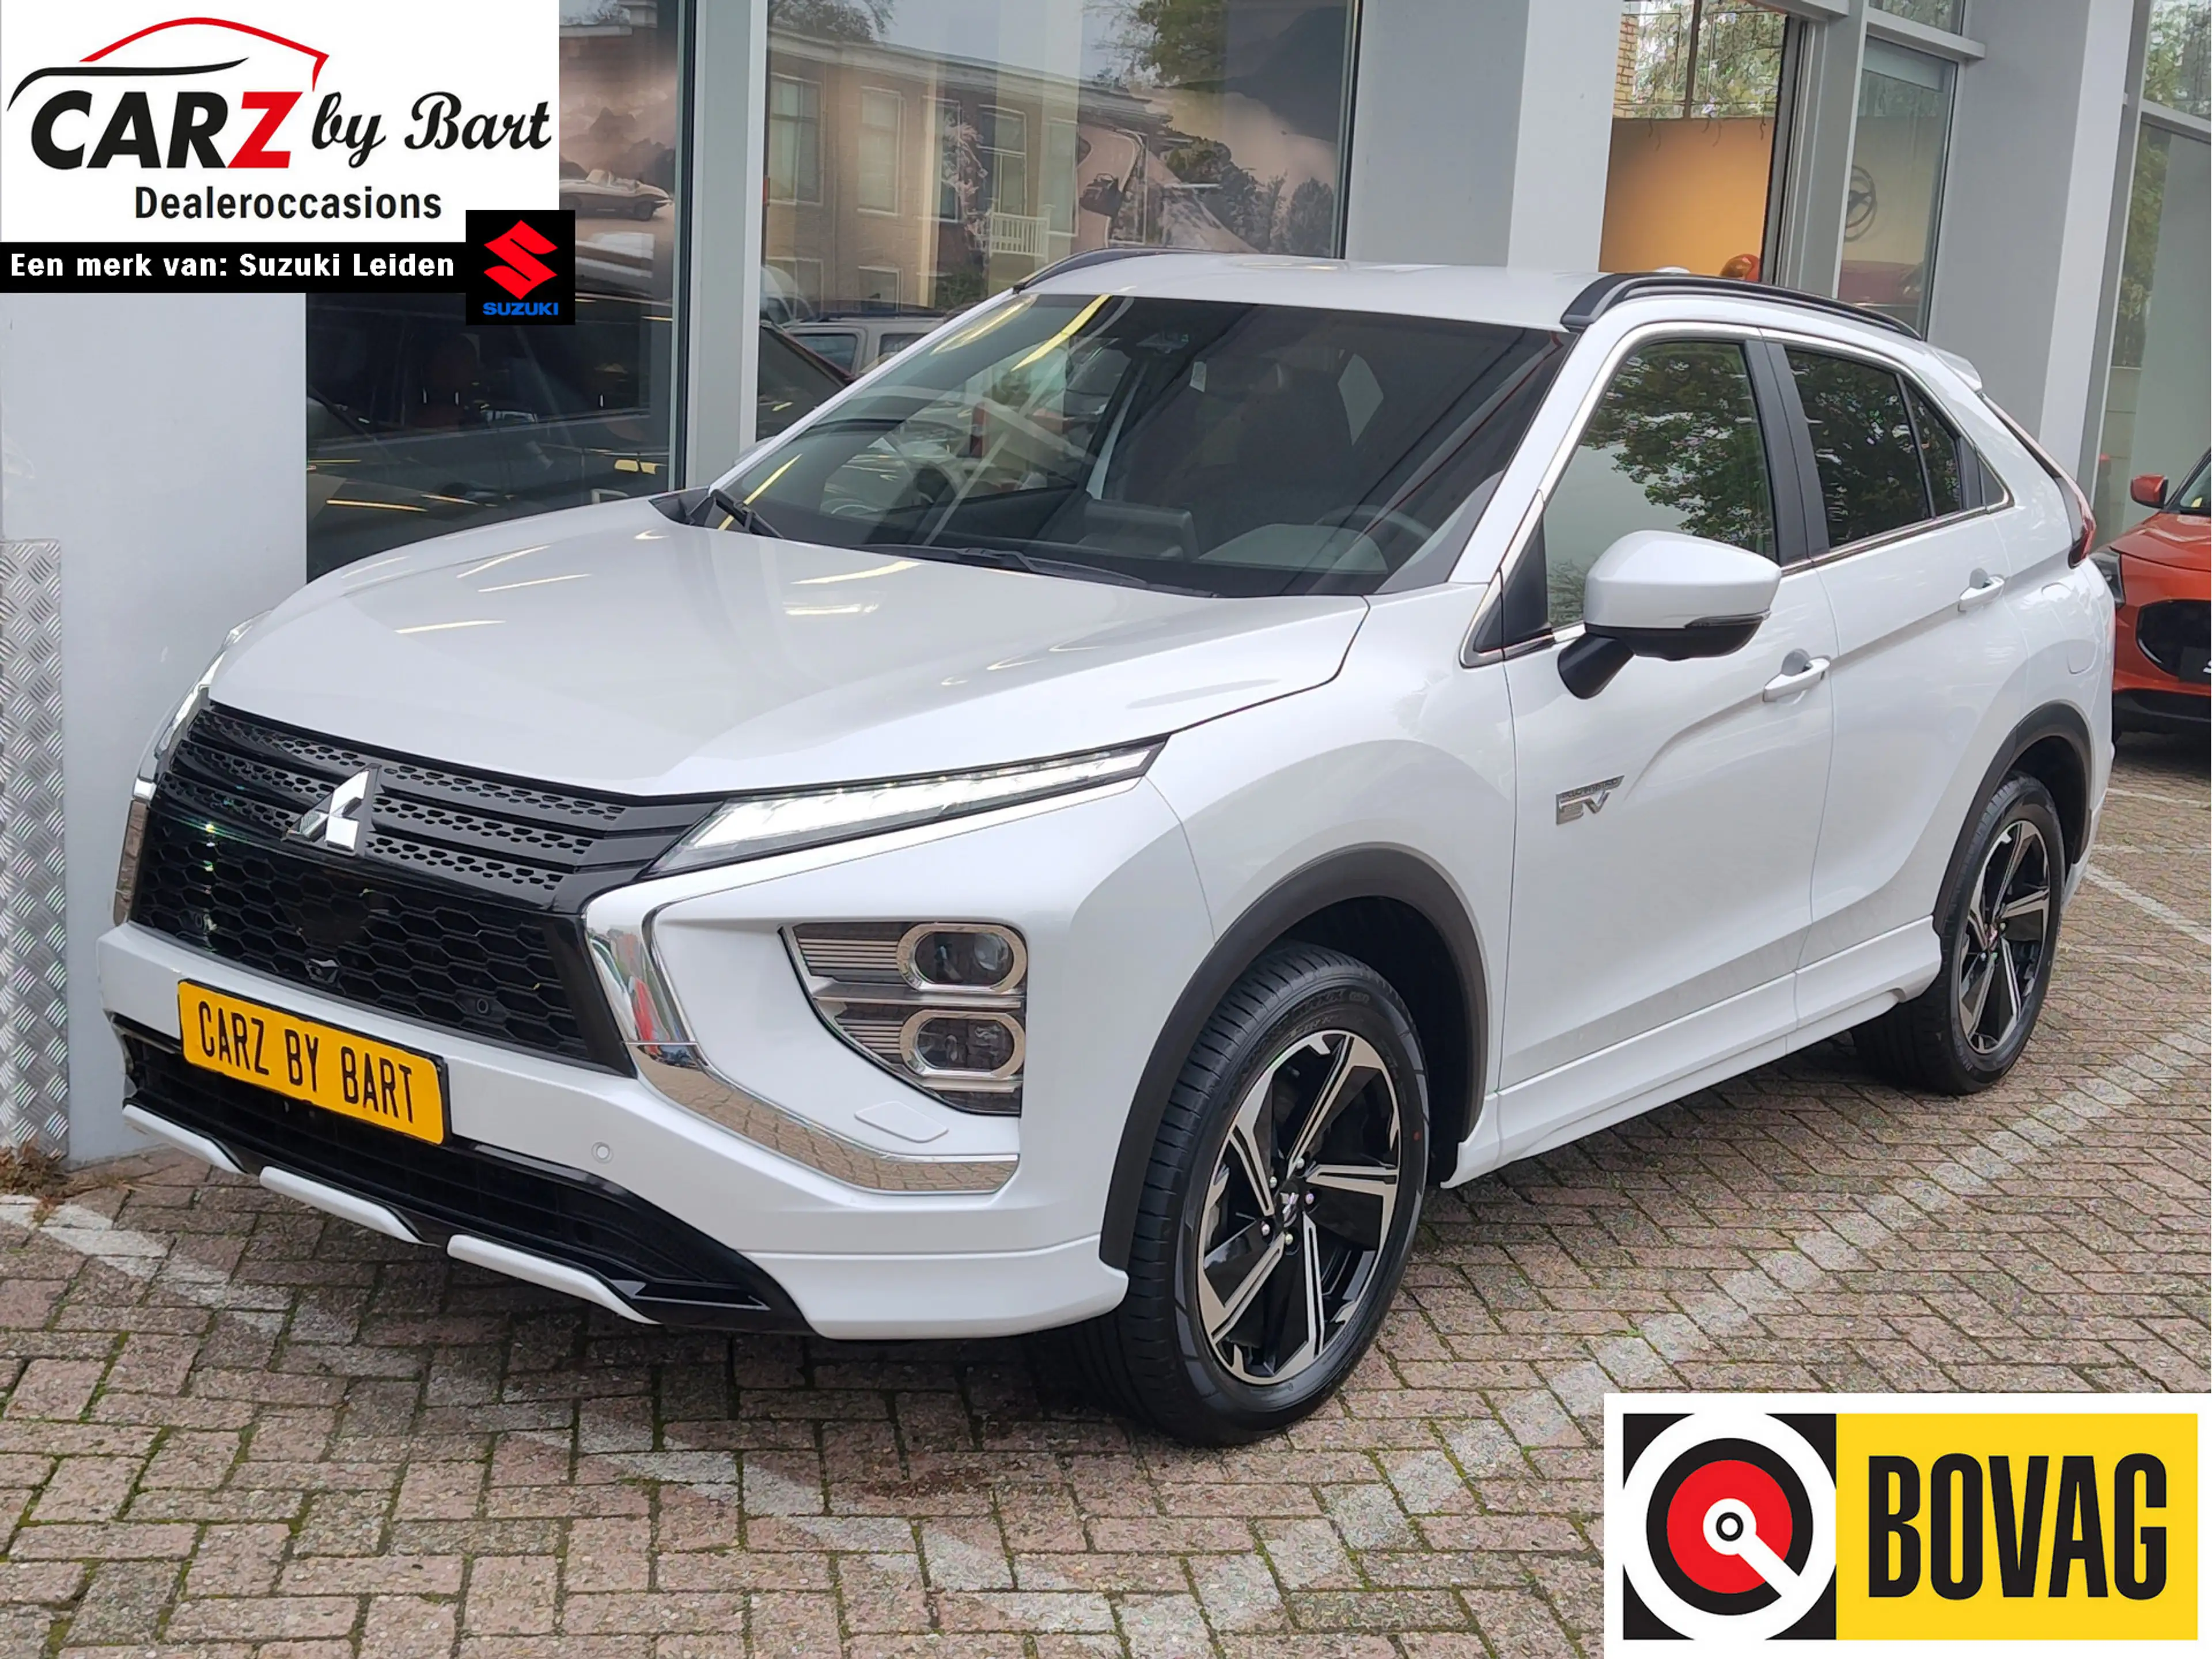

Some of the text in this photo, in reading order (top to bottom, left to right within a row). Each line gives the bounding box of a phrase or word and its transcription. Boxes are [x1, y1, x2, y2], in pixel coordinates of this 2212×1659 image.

[198, 1001, 414, 1123] CARZ BY BART
